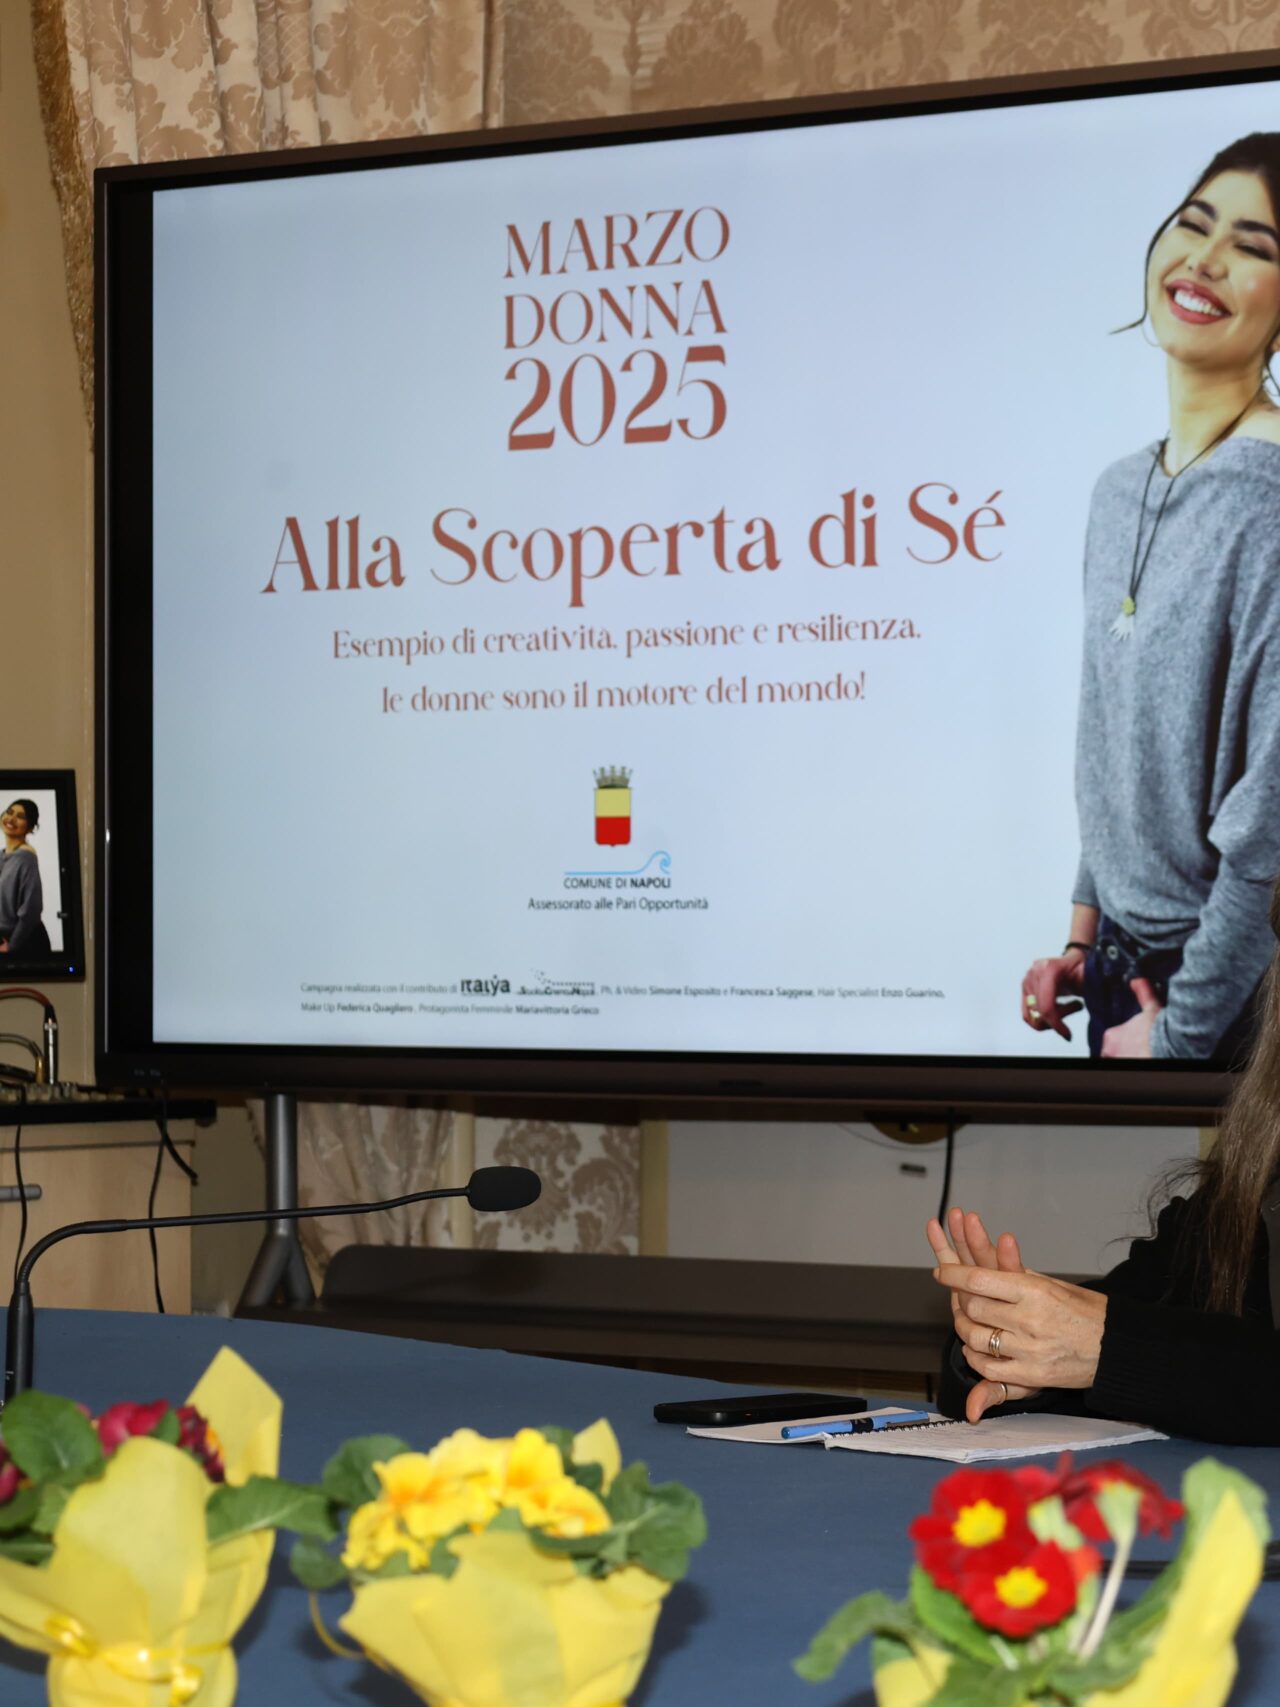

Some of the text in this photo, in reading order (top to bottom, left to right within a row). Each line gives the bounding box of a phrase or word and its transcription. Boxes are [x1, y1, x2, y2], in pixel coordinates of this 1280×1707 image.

[504, 206, 731, 279] MARZO
[503, 279, 729, 349] DONNA
[503, 344, 728, 451] 2025
[260, 481, 1007, 608] Alla Scoperta di Sé
[333, 629, 445, 666] Esempio
[452, 627, 476, 654] di
[625, 620, 745, 659] passione
[753, 623, 769, 644] e
[382, 670, 867, 713] le donne sono il motore del mondo!
[527, 897, 709, 913] Assessorato alle Pari Opportunità
[563, 877, 672, 889] COMUNE DI NAPOLI
[300, 981, 343, 995] Campagna
[649, 984, 682, 995] Simone
[684, 984, 720, 997] Esposito
[730, 984, 773, 996] Francesca
[301, 1001, 322, 1012] Make
[323, 1002, 335, 1014] Up
[336, 1002, 371, 1012] Federica
[571, 1004, 600, 1015] Grieco
